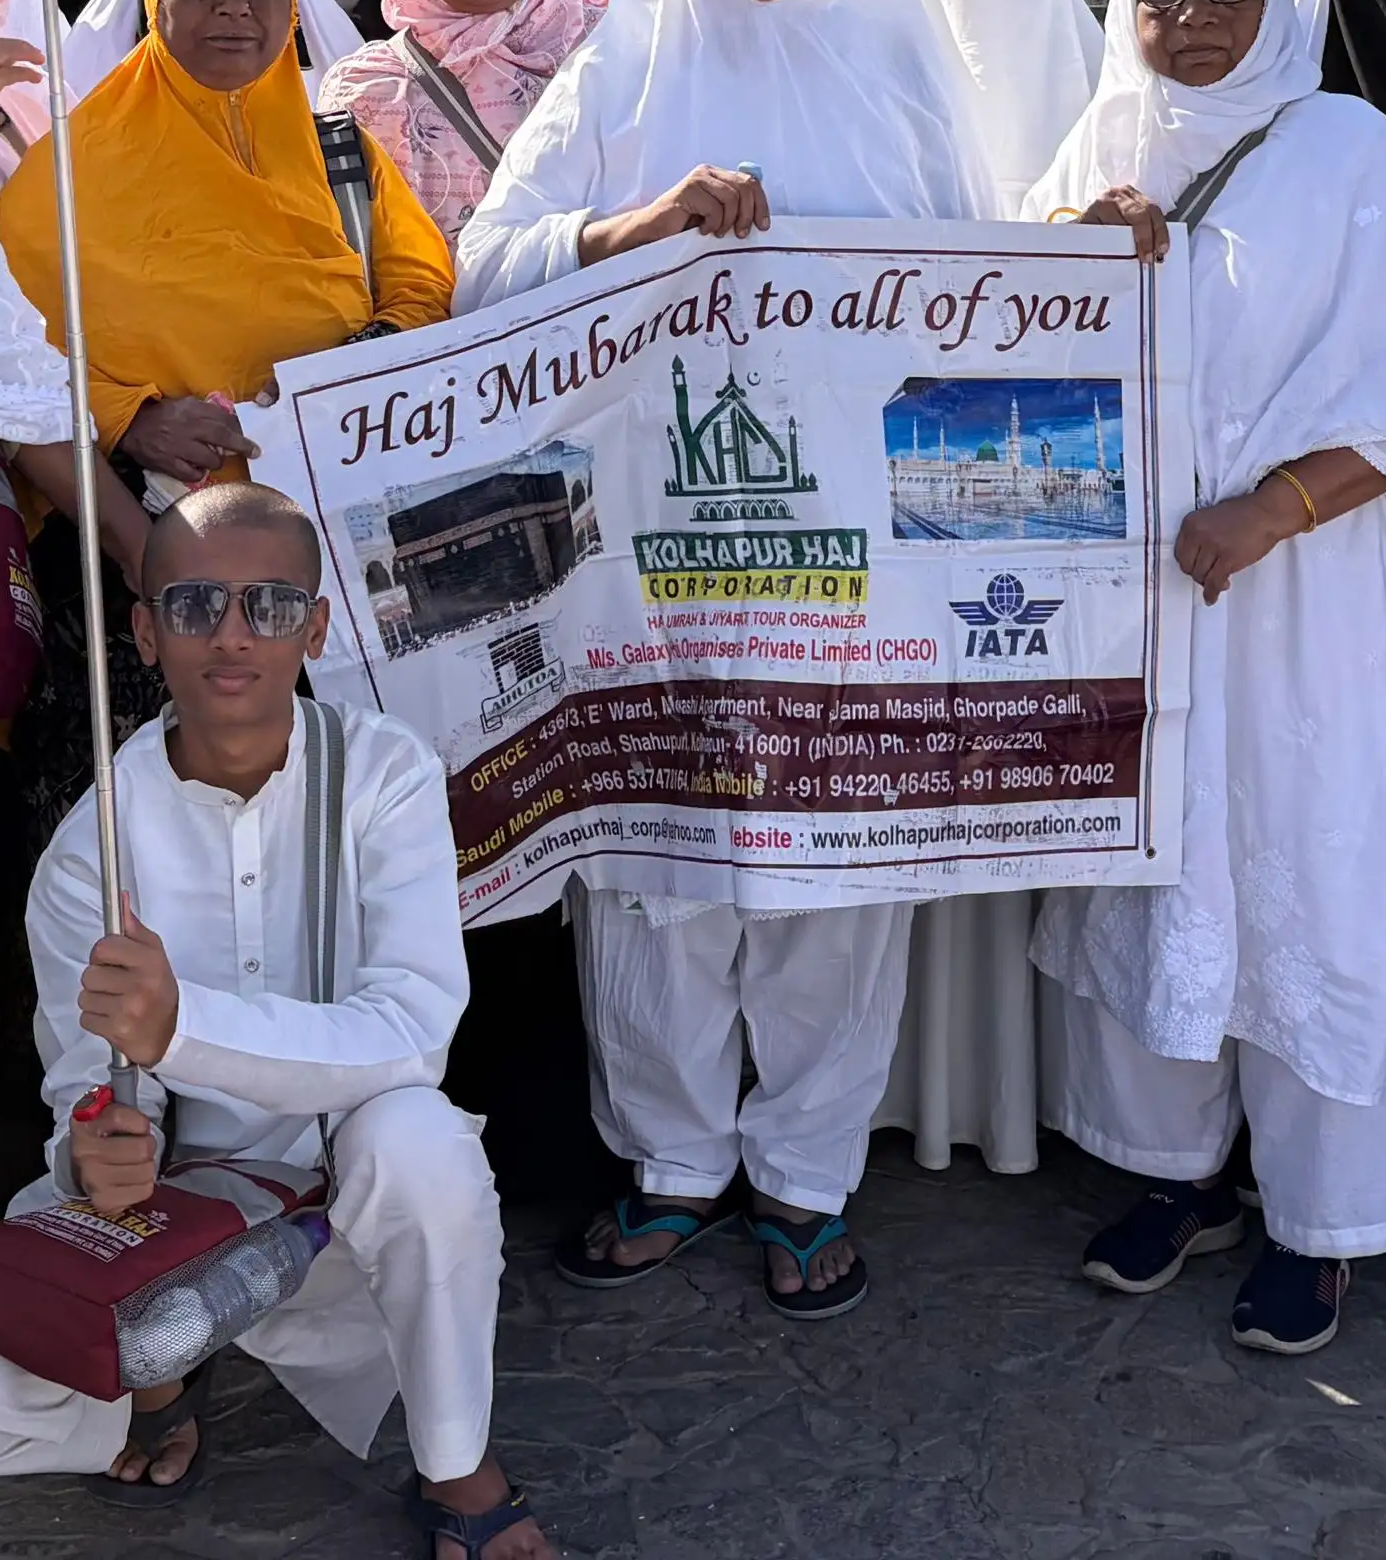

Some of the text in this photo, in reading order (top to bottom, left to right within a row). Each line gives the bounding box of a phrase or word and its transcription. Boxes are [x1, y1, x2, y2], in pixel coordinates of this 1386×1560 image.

[340, 269, 1111, 466] Haj Mubarak to all of you
[641, 534, 862, 570] KOLHAPUR HAJ
[649, 575, 862, 599] CORPORATION
[647, 614, 664, 631] HA
[667, 612, 699, 628] UMRAH
[752, 611, 786, 627] TOUR
[789, 612, 867, 630] ORGANIZER
[965, 628, 1049, 658] IATA
[587, 647, 620, 670] M/s.
[622, 642, 673, 666] Galaxy
[748, 635, 806, 660] Private
[811, 639, 871, 664] Limited
[876, 638, 938, 667] (CHGO)
[470, 739, 529, 792] OFFICE
[609, 698, 658, 723] Ward,
[778, 697, 824, 720] Near
[830, 700, 880, 722] Jama
[885, 697, 951, 724] Masjid,
[953, 695, 1038, 721] Ghorpade
[1042, 693, 1087, 718] Galli,
[512, 752, 564, 799] Station
[566, 739, 618, 763] Road,
[734, 733, 800, 757] 416001
[808, 733, 876, 762] (INDIA)
[880, 733, 911, 756] Ph.
[456, 825, 506, 868] Saudi
[508, 788, 565, 837] Mobile
[580, 769, 624, 795] +966
[785, 775, 822, 798] +91
[829, 773, 891, 797] 94220
[895, 770, 955, 795] 46455,
[959, 768, 994, 791] +91
[1000, 764, 1054, 789] 98906
[1059, 761, 1115, 786] 70402
[458, 866, 512, 911] E-mail
[730, 825, 793, 849] ebsite
[811, 813, 1122, 849] www.kolhapurhajcorporation.com
